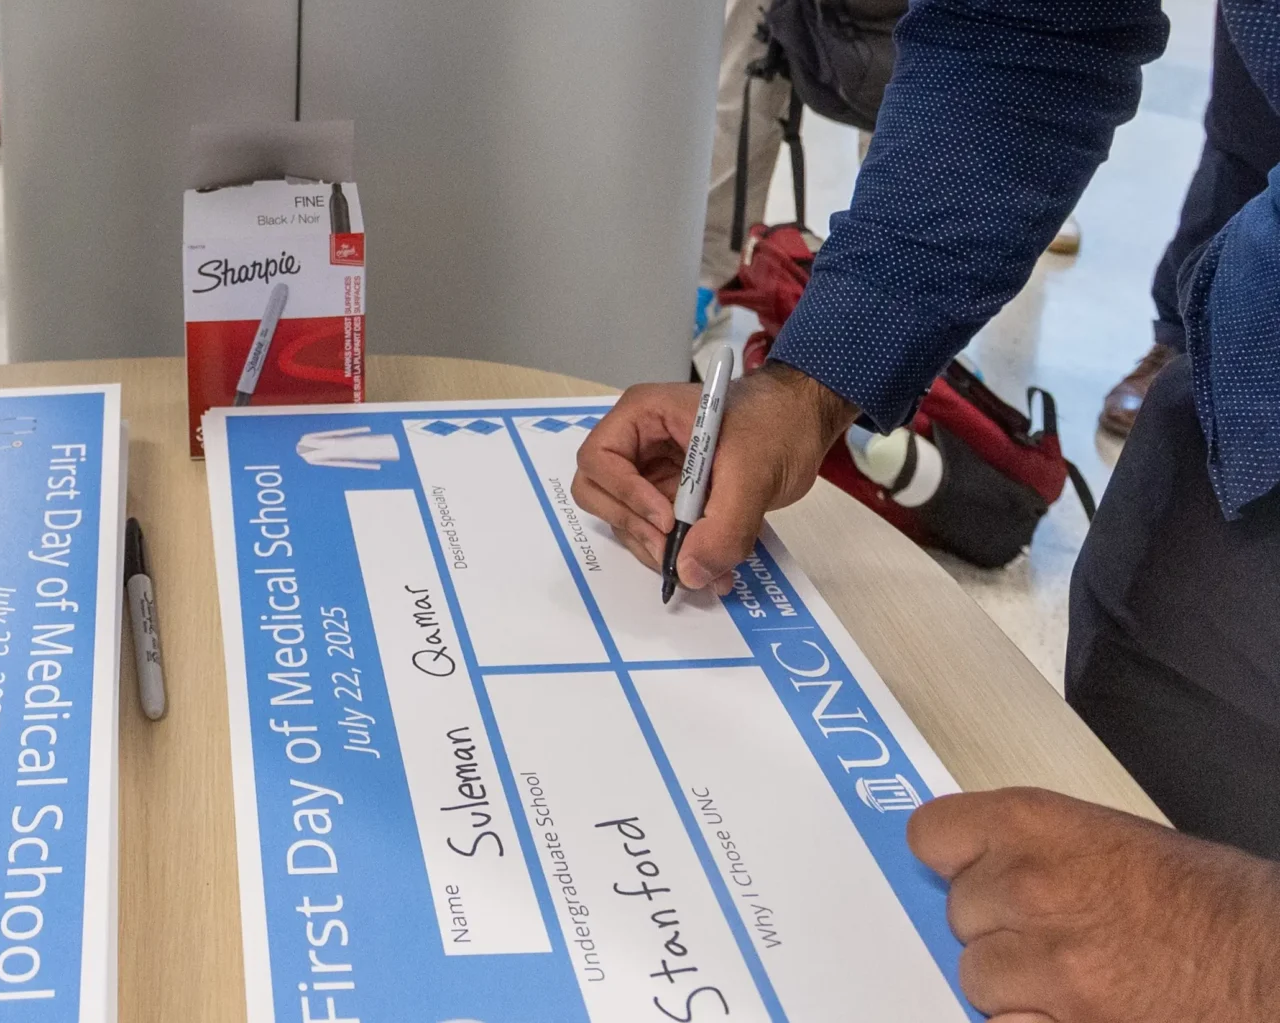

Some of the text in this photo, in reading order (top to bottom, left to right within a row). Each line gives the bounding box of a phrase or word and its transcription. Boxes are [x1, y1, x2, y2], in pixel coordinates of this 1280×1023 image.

[257, 215, 288, 226] Black
[298, 213, 321, 224] Noir
[294, 196, 325, 208] FINE
[192, 251, 301, 293] Sharpie
[46, 443, 87, 501] First
[28, 509, 82, 568] Day
[431, 485, 468, 570] Desired Specialty
[548, 477, 602, 572] Most Excited About
[35, 577, 79, 613] of
[731, 569, 766, 618] SCHOO
[16, 623, 75, 787] Medical
[320, 606, 380, 759] July 22, 2025
[770, 640, 890, 774] UNC
[244, 464, 361, 1023] First Day of Medical School
[404, 585, 505, 857] Suleman Qamar
[691, 786, 723, 825] UNC
[520, 772, 605, 983] Undergraduate School
[717, 830, 752, 887] Chose
[445, 884, 471, 943] Name
[594, 817, 730, 1023] Stanford
[751, 902, 782, 949] Why
